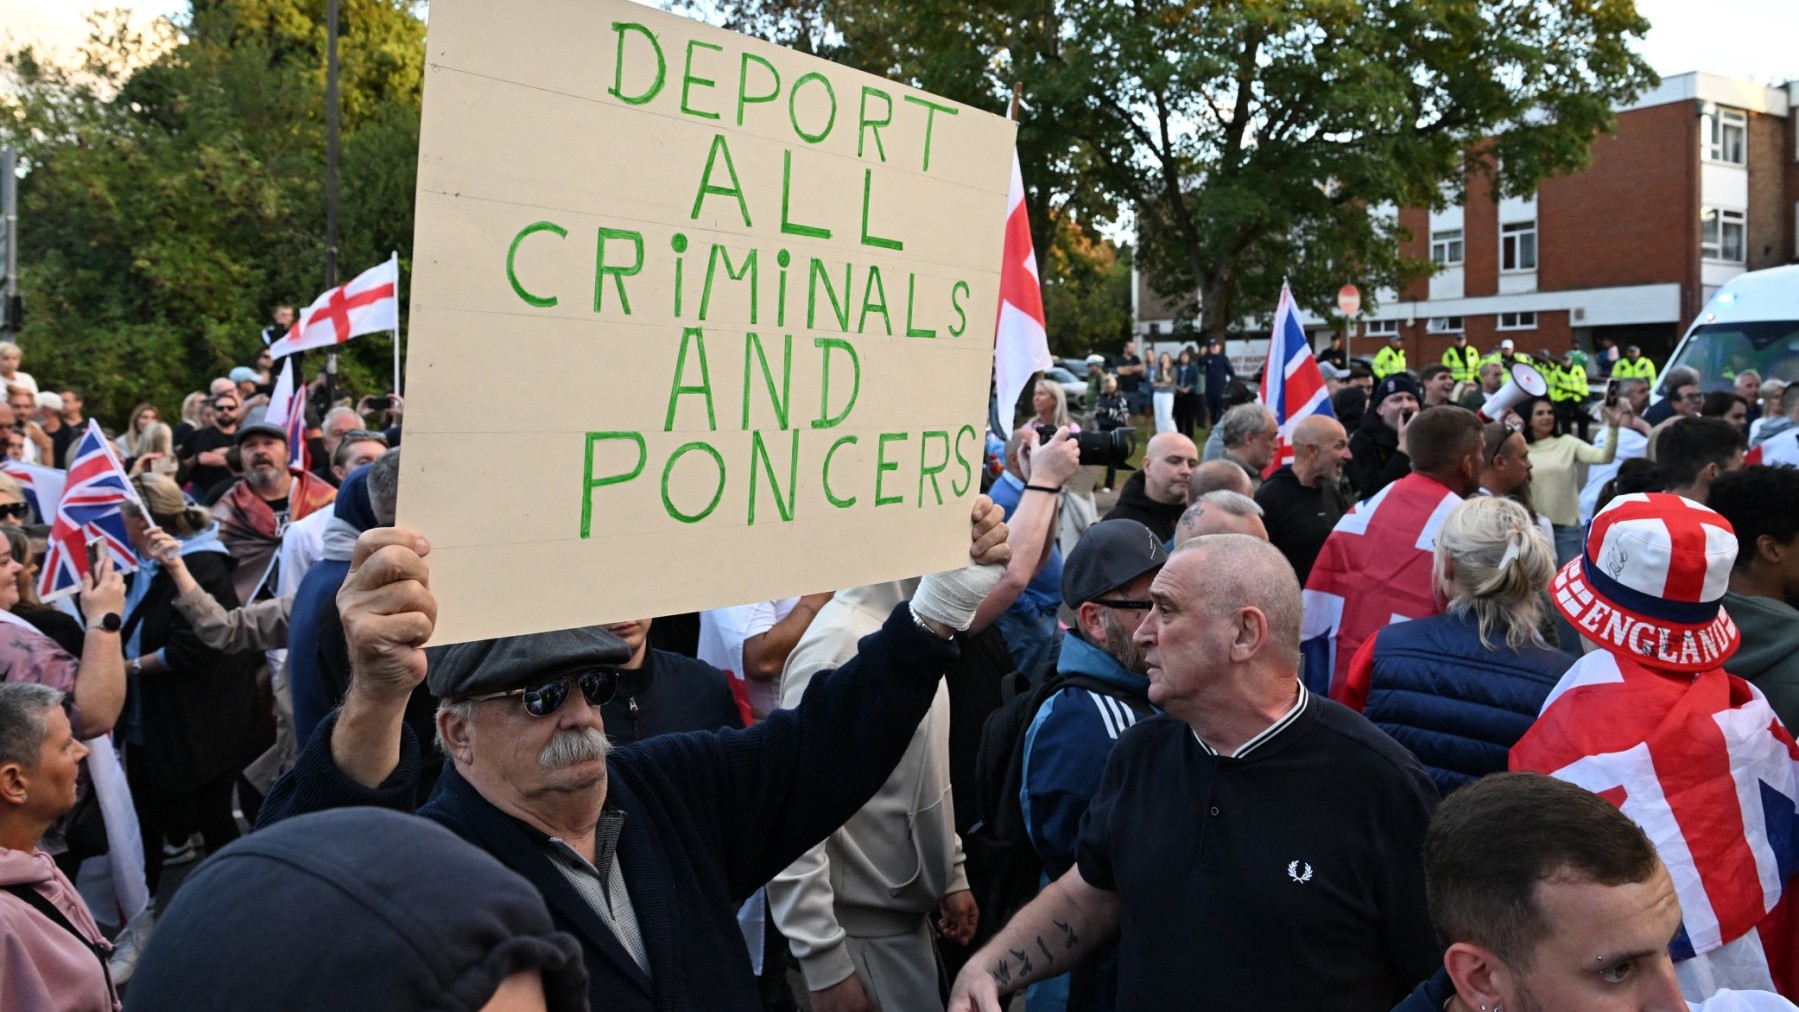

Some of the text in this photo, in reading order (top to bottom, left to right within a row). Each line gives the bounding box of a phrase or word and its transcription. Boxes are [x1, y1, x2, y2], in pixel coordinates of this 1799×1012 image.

[608, 22, 959, 171] DEPORT
[692, 135, 904, 251] ALL
[665, 327, 861, 431] AND
[580, 425, 977, 539] PONCERS
[1578, 600, 1730, 664] ENGLAND
